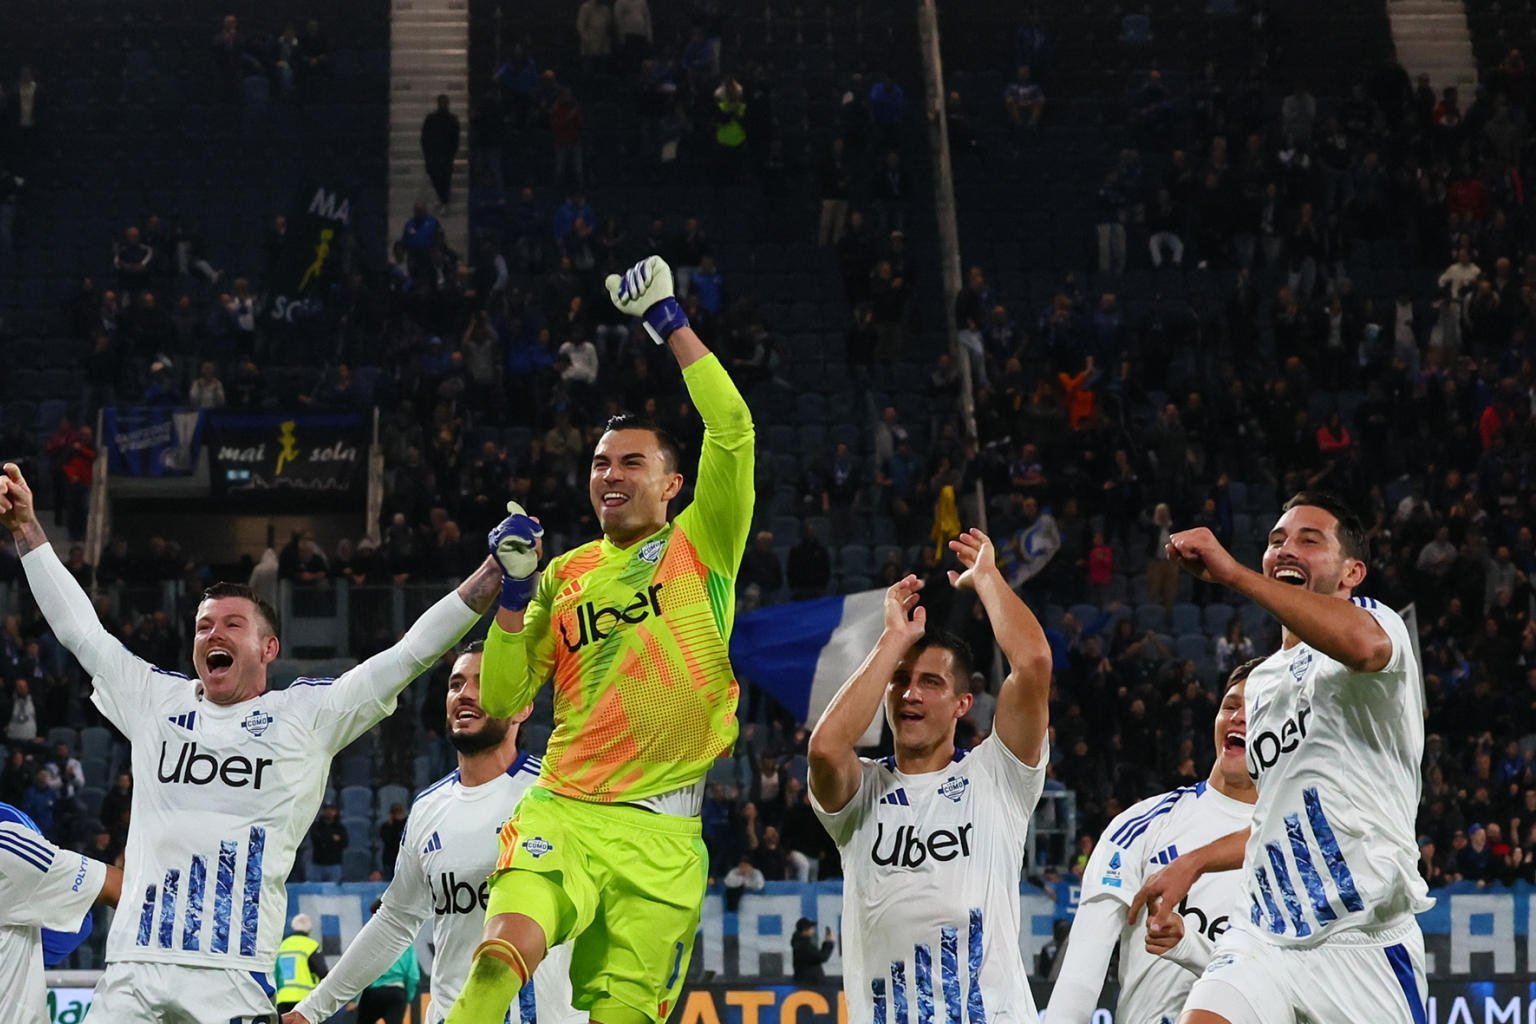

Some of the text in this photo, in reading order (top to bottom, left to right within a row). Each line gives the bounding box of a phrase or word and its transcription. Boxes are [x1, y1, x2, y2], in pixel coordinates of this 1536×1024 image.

[218, 440, 356, 463] mai sola
[560, 583, 663, 653] Uber
[247, 717, 267, 728] COMO
[157, 741, 273, 790] Uber
[871, 822, 973, 868] Uber
[666, 941, 684, 989] 1
